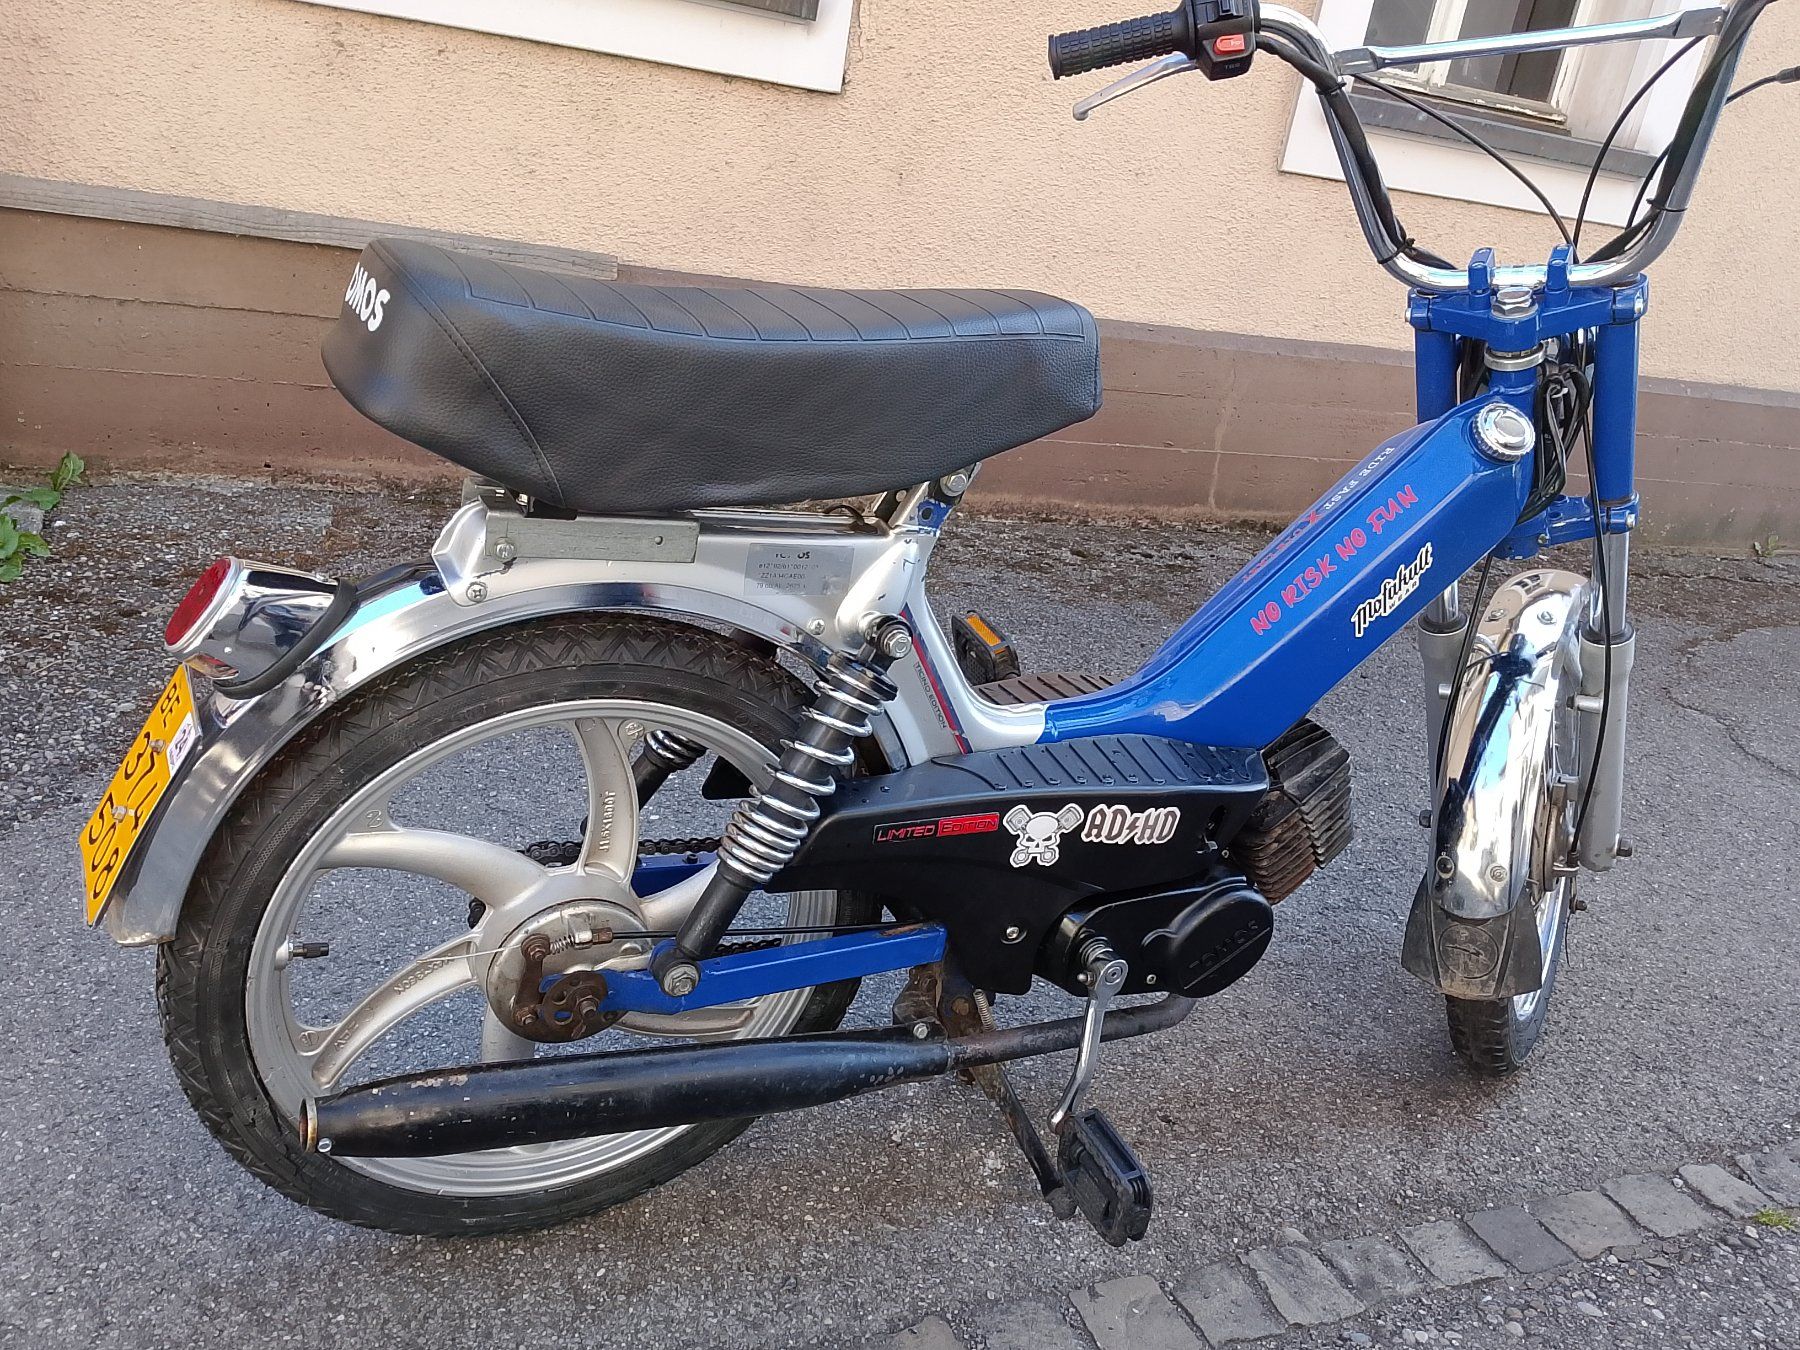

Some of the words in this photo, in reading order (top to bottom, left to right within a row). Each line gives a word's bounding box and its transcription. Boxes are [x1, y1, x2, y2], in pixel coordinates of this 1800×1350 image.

[1324, 479, 1359, 509] FAST
[1359, 447, 1395, 477] RIDE
[1250, 601, 1282, 635] NO
[1281, 554, 1337, 608] RISK
[1335, 527, 1367, 561] NO
[1366, 484, 1418, 534] FUN
[1352, 543, 1432, 636] Mofakult
[160, 682, 182, 728] BE
[915, 660, 931, 693] TICINO
[928, 693, 947, 729] EDITION
[124, 731, 158, 834] 374
[88, 792, 120, 900] 508
[877, 824, 936, 843] LIMITED
[940, 819, 998, 836] EDITION
